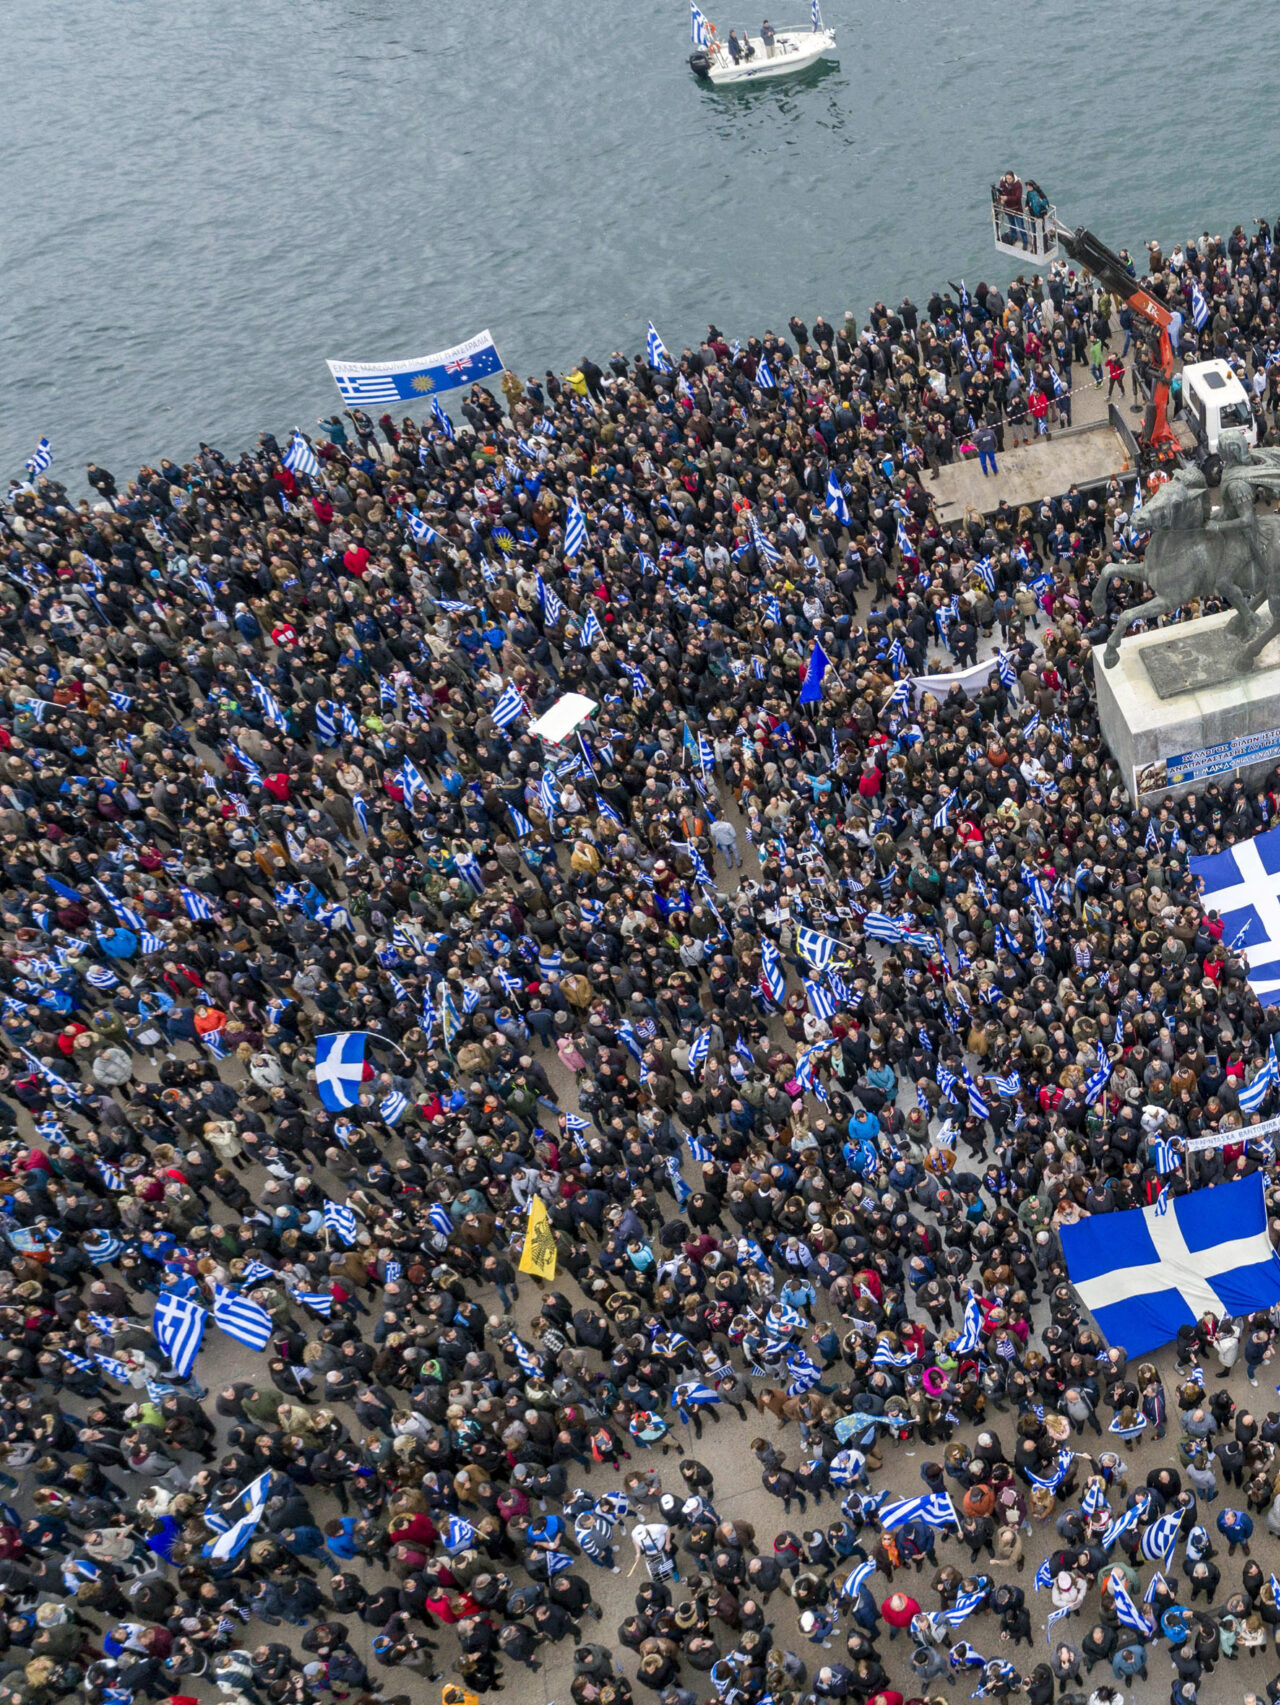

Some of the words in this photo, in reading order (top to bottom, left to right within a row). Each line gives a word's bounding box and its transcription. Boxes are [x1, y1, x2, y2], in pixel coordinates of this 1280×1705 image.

[1170, 748, 1246, 773] ΑΝΑΠΑΡΑΣΤΑΣΗΣ
[1182, 744, 1228, 762] ΣΥΛΛΟΓΟΣ
[1231, 736, 1259, 748] ΦΙΛΩΝ
